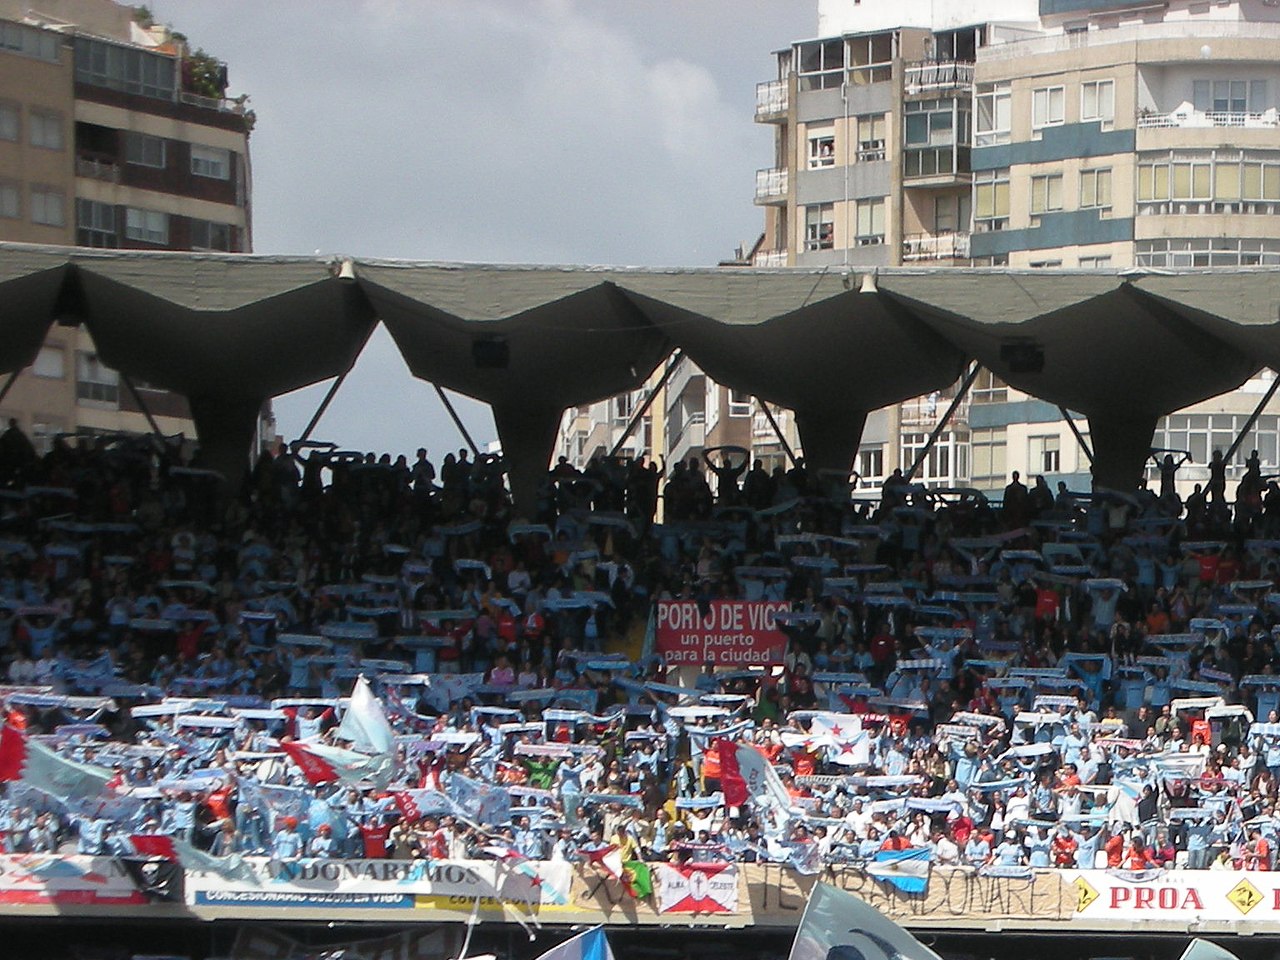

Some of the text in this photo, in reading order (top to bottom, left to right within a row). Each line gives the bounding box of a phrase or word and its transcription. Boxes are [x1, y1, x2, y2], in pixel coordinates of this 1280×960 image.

[721, 604, 743, 630] DE
[681, 633, 754, 650] un puerto
[665, 647, 770, 664] para la ciudad
[1109, 886, 1205, 910] PROA
